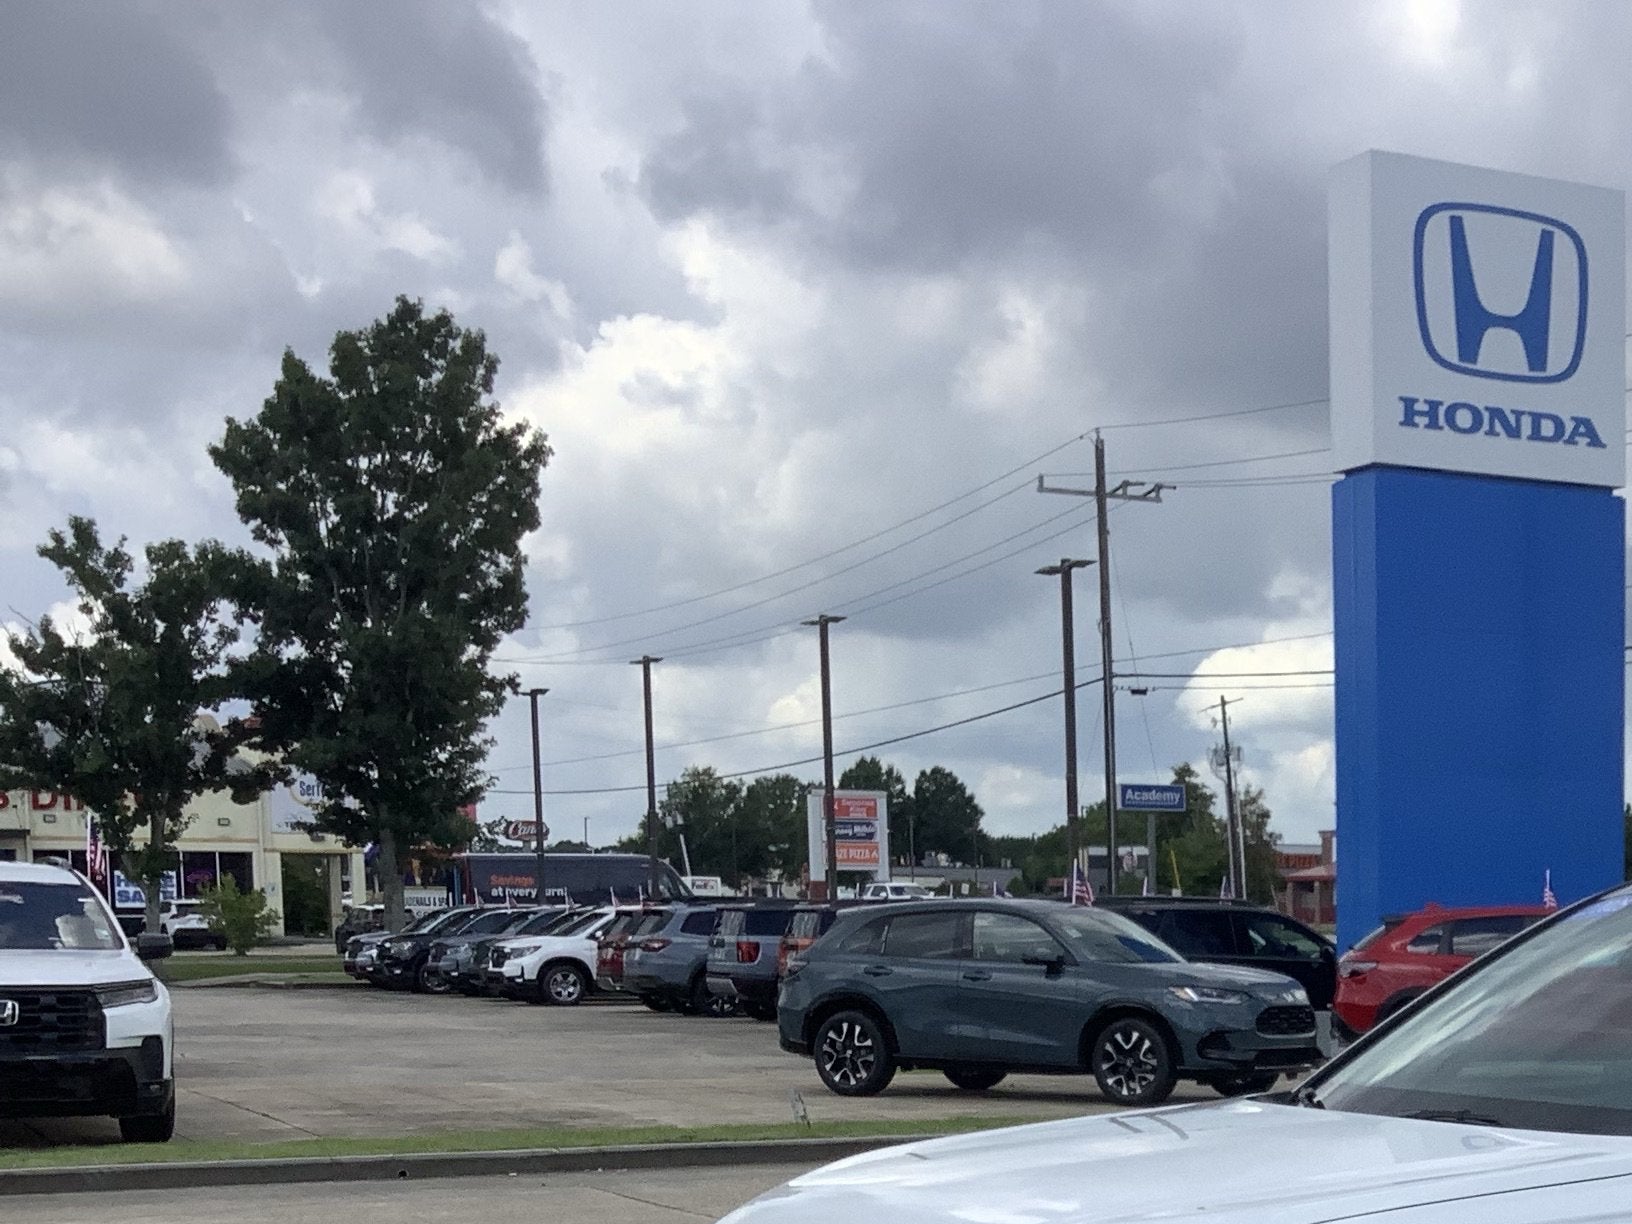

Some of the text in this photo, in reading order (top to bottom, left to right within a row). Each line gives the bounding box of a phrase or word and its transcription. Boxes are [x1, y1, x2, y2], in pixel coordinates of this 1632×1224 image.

[1398, 396, 1607, 449] HONDA
[1126, 788, 1180, 804] Academy
[849, 848, 871, 859] PIZZA
[490, 874, 535, 887] Savings
[491, 886, 503, 897] at
